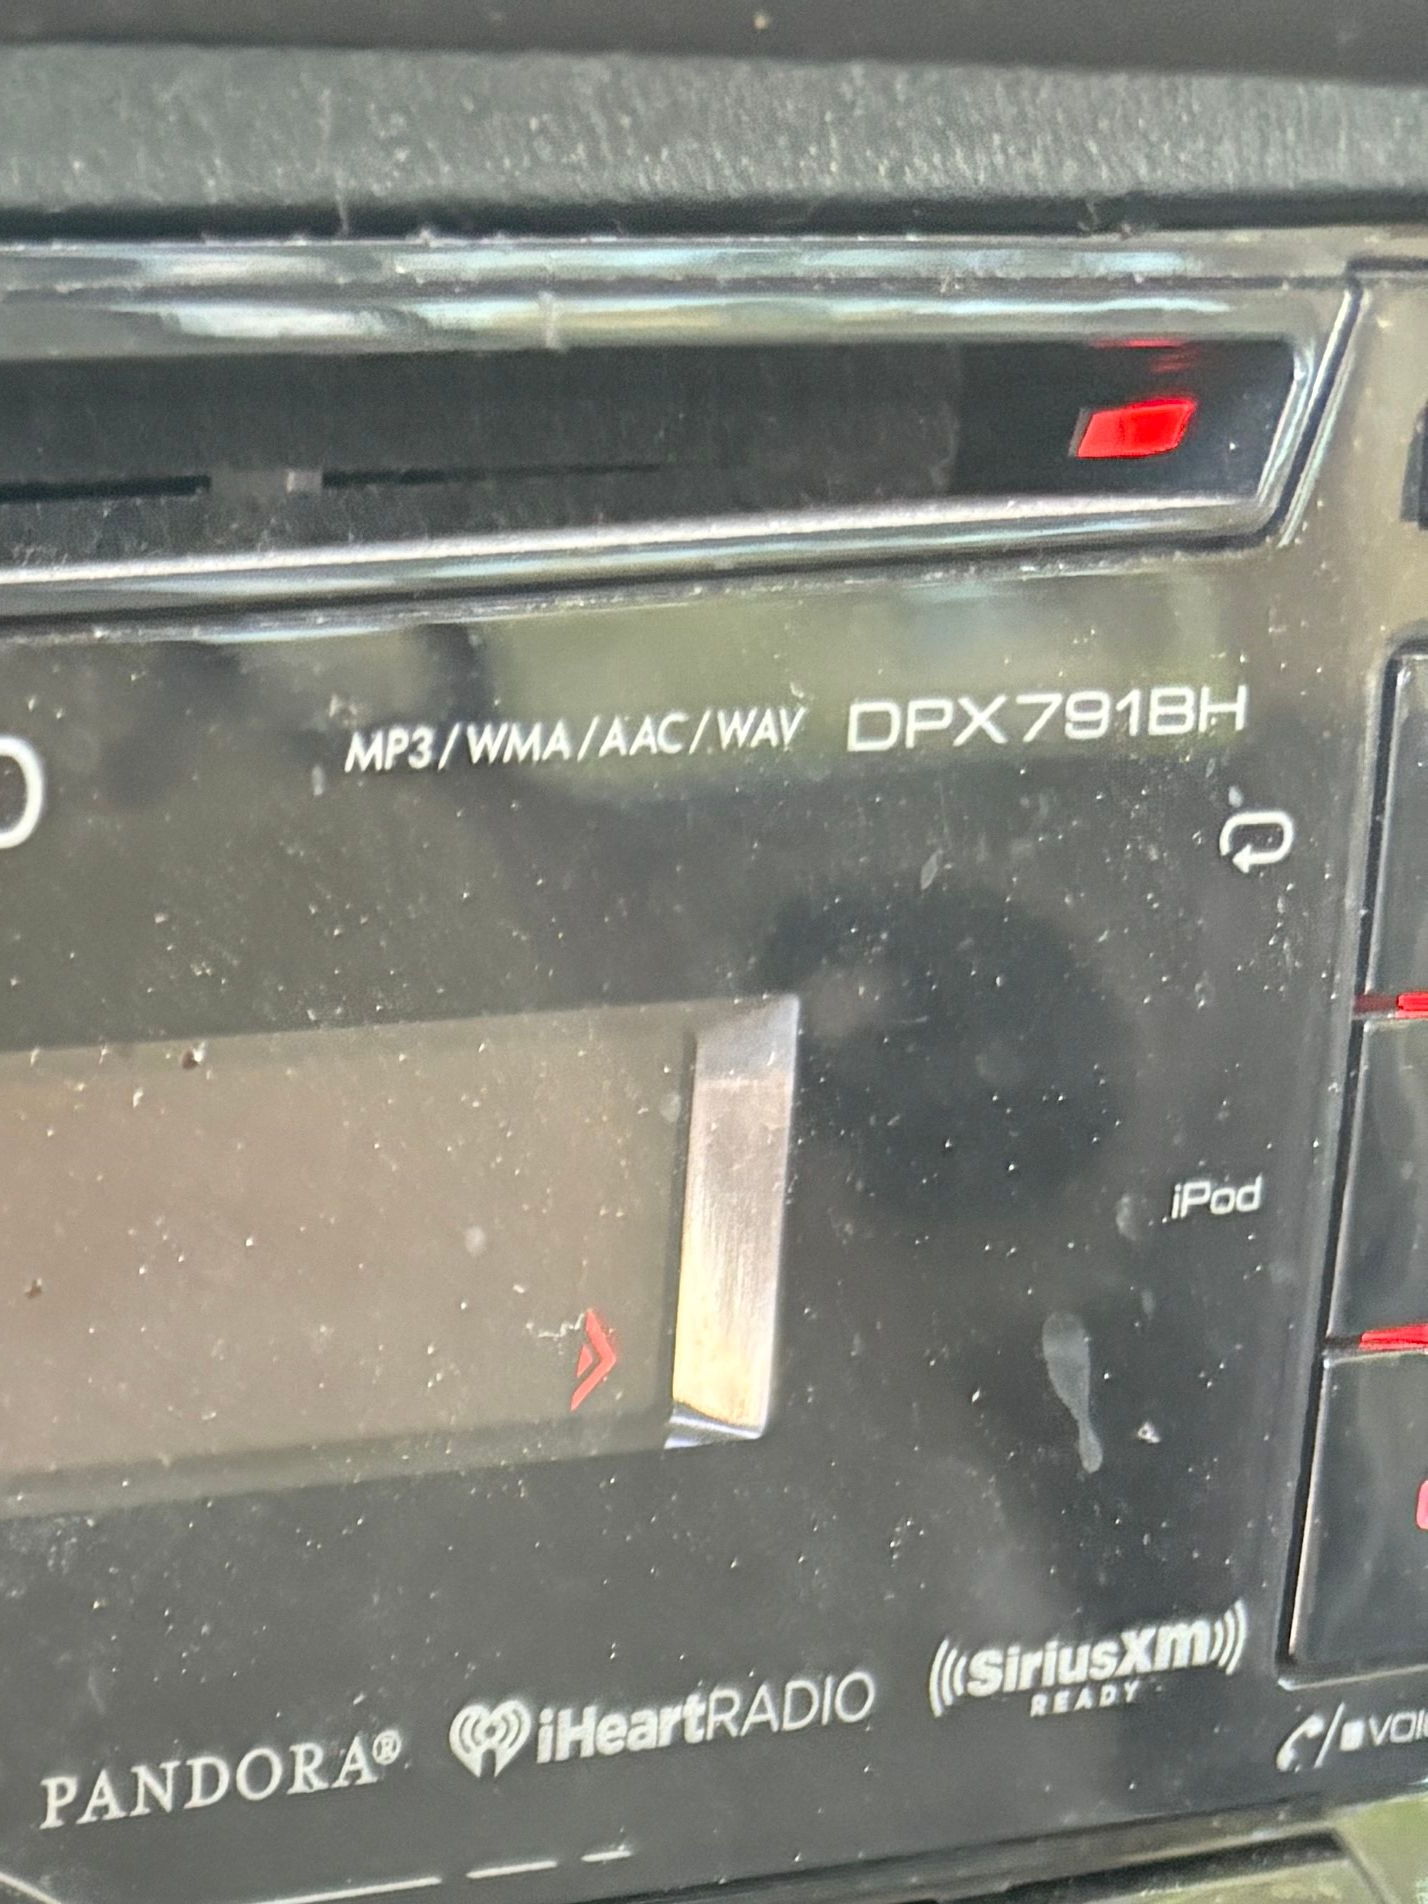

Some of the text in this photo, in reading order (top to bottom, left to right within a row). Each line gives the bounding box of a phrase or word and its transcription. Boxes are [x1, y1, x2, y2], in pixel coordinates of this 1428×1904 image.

[345, 704, 807, 772] MP3/WMA/AAC/WAV
[847, 684, 1248, 752] DPX791BH
[1169, 1176, 1262, 1220] iPod
[537, 1670, 876, 1763] iHeartRADIO
[1029, 1681, 1141, 1717] READY
